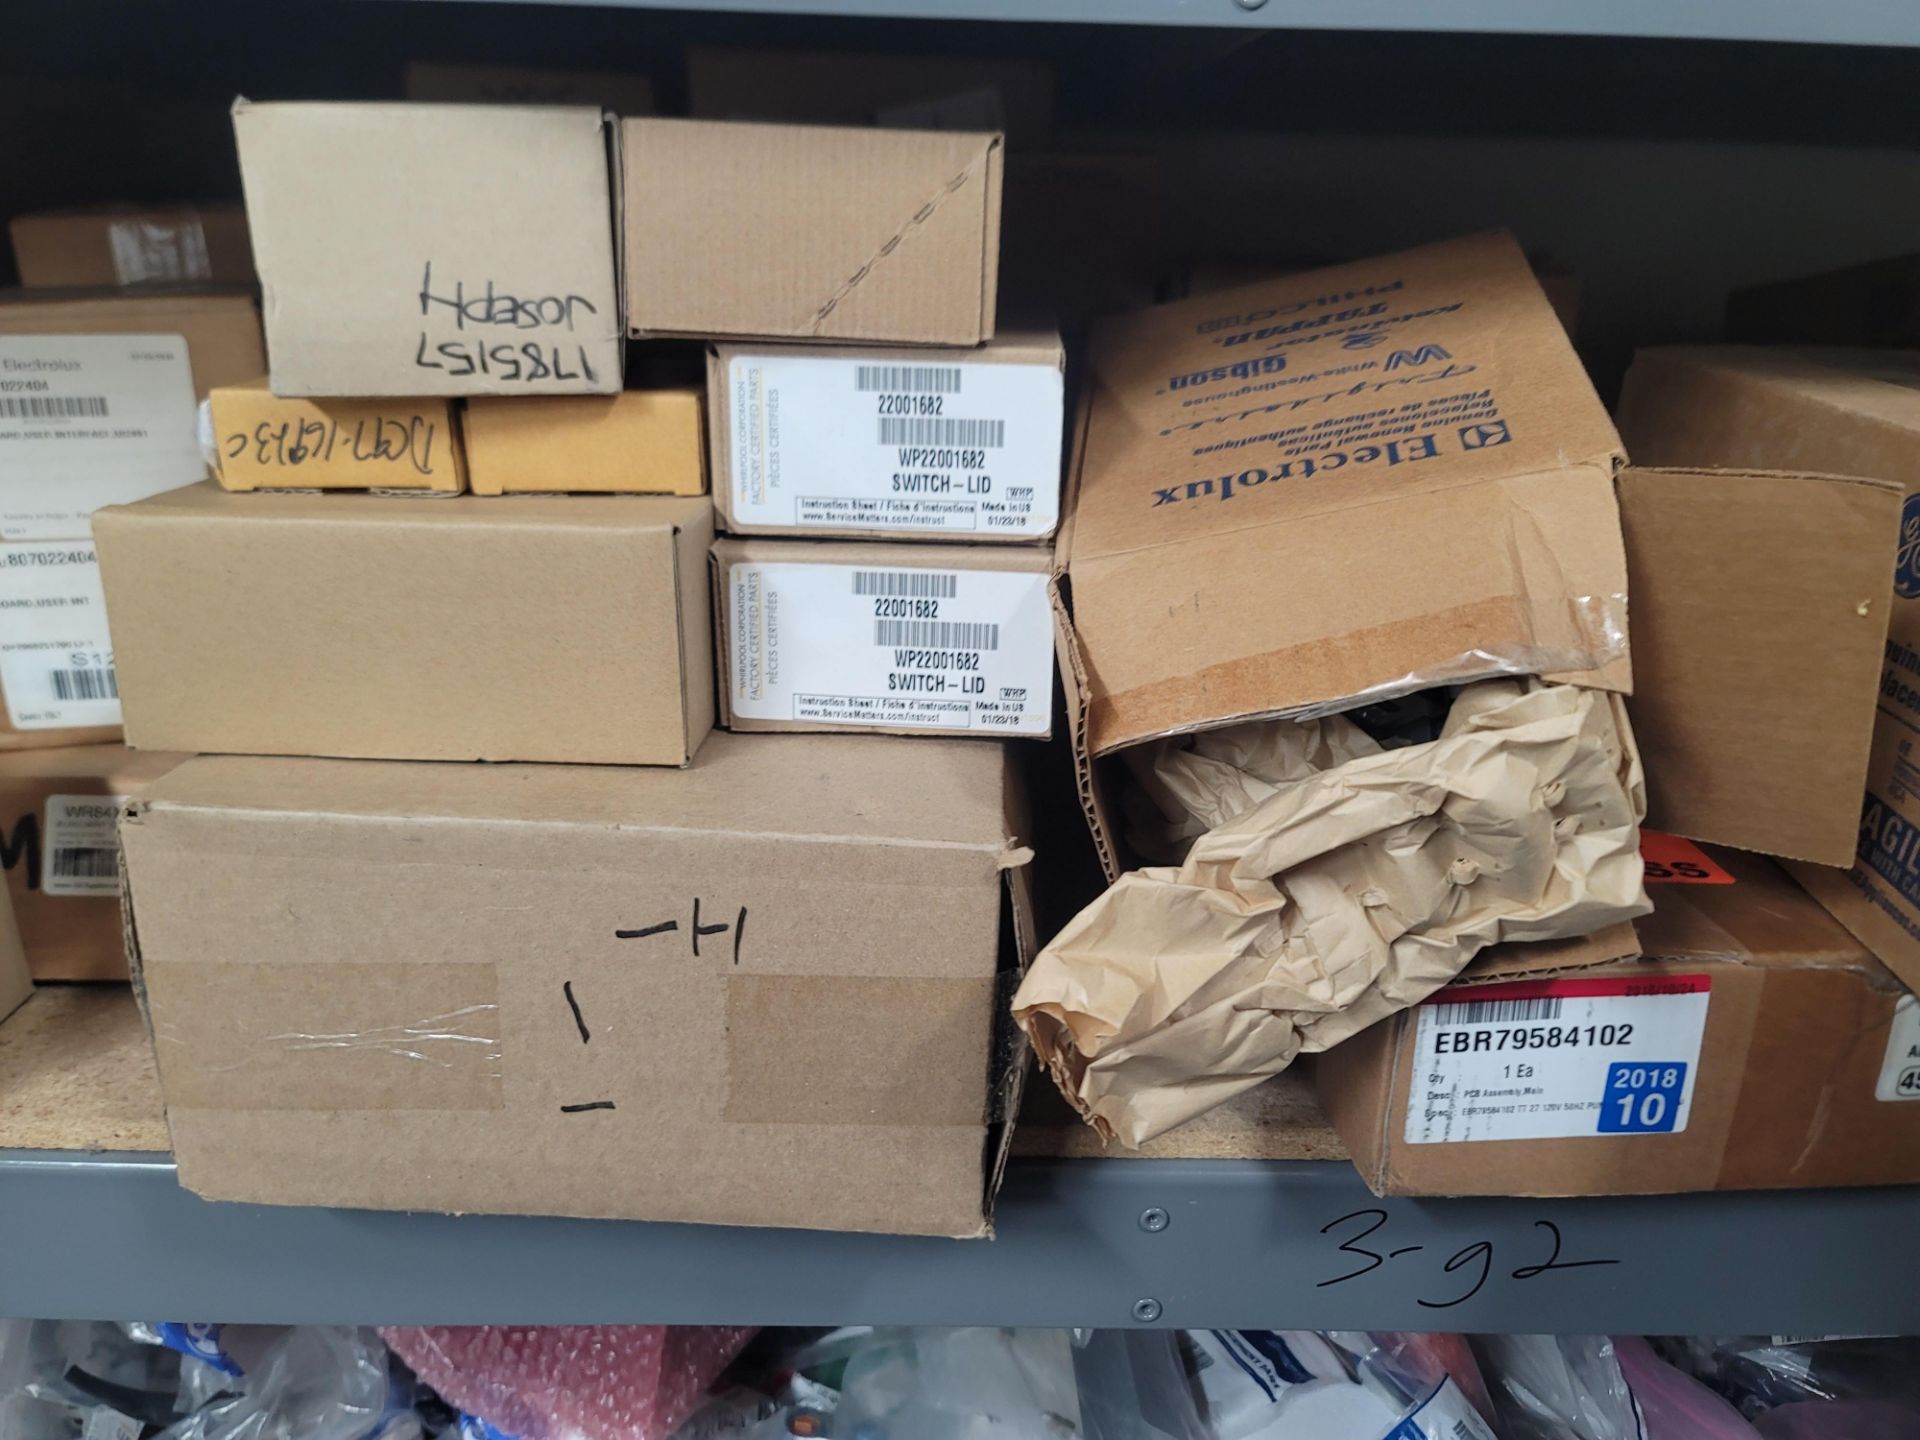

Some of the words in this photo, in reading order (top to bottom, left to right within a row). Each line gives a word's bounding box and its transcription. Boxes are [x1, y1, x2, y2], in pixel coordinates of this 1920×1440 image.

[1169, 353, 1286, 390] Gibson
[878, 394, 943, 416] 22001682
[1400, 402, 1423, 412] de
[899, 448, 985, 470] WP22001682
[1152, 433, 1443, 508] Electrolux
[875, 598, 938, 618] 22001682
[895, 650, 979, 670] WP22001682
[1435, 1024, 1634, 1054] EBR79584102
[1503, 1065, 1511, 1078] 1
[1517, 1064, 1534, 1078] Ea
[1614, 1069, 1677, 1089] 2018
[1617, 1093, 1664, 1126] 10
